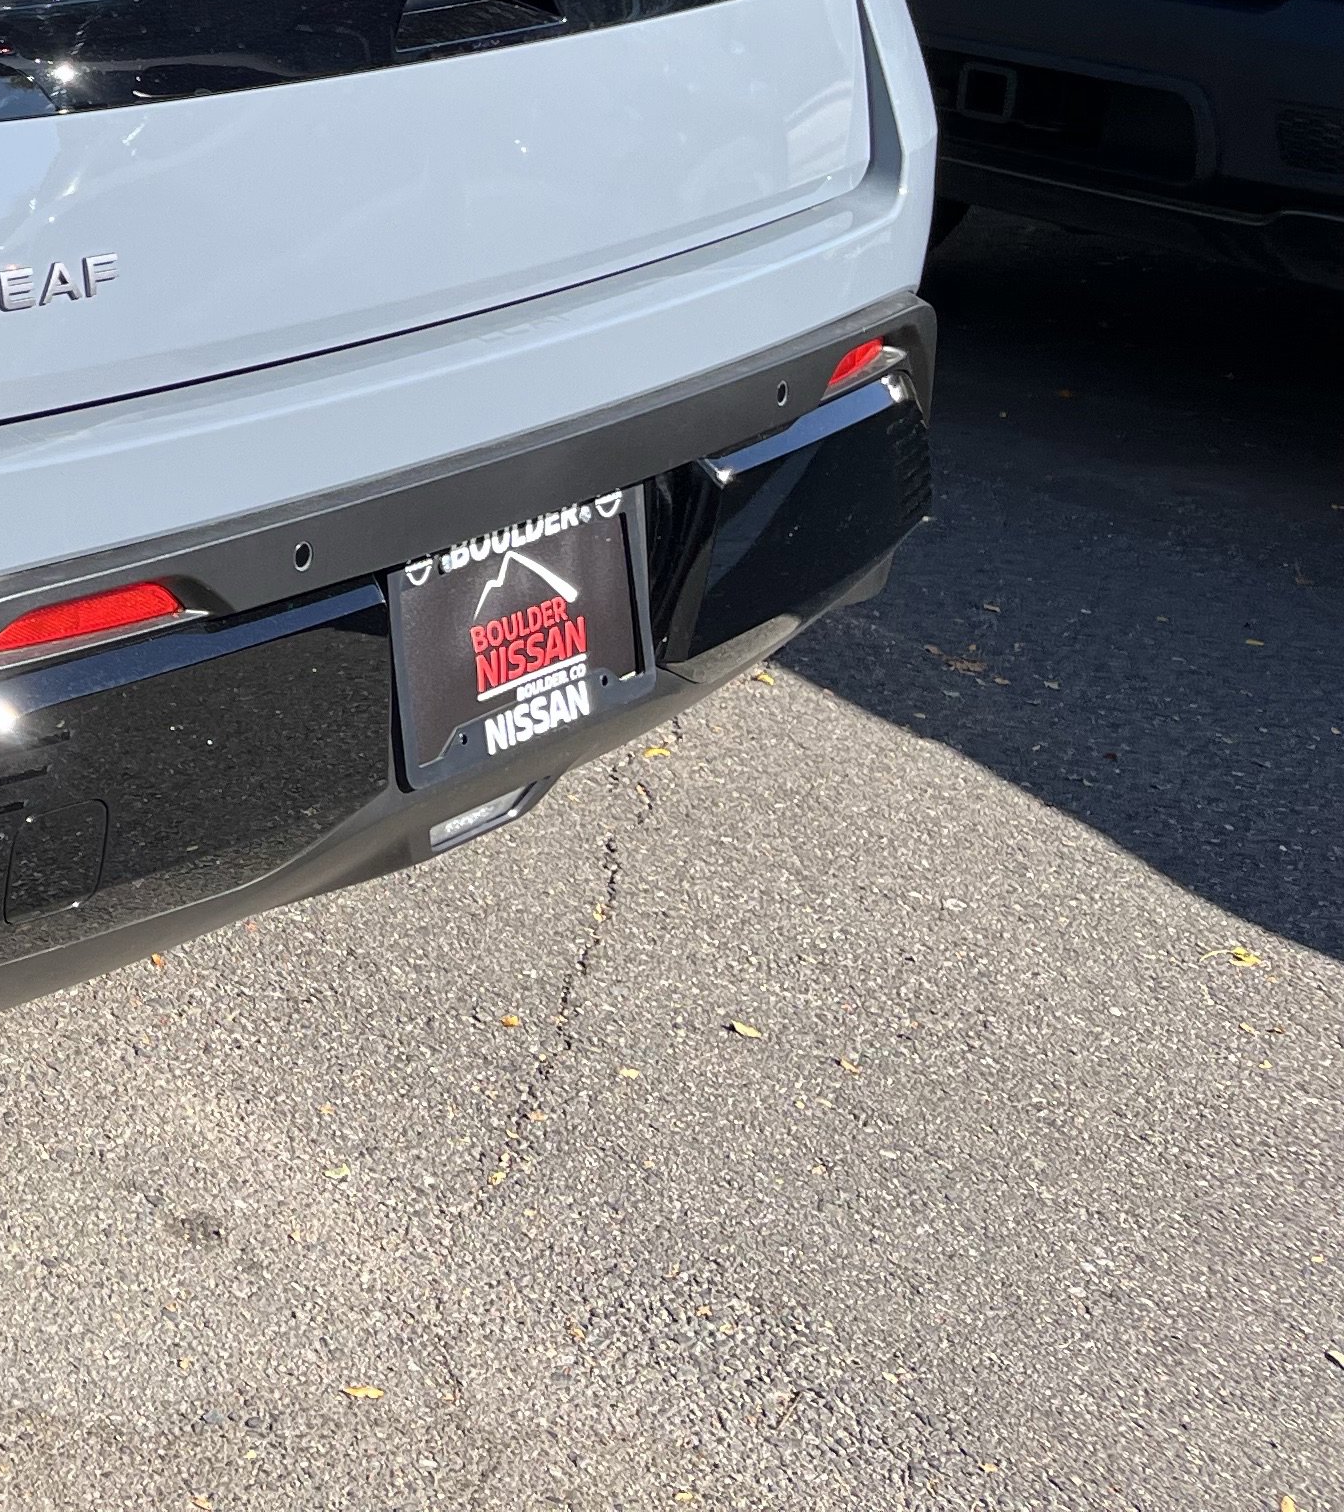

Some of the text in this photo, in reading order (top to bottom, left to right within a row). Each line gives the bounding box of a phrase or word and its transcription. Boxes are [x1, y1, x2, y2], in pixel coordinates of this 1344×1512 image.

[469, 596, 568, 654] BOULDER
[475, 615, 587, 693] NISSAN
[483, 680, 591, 756] NISSAN
